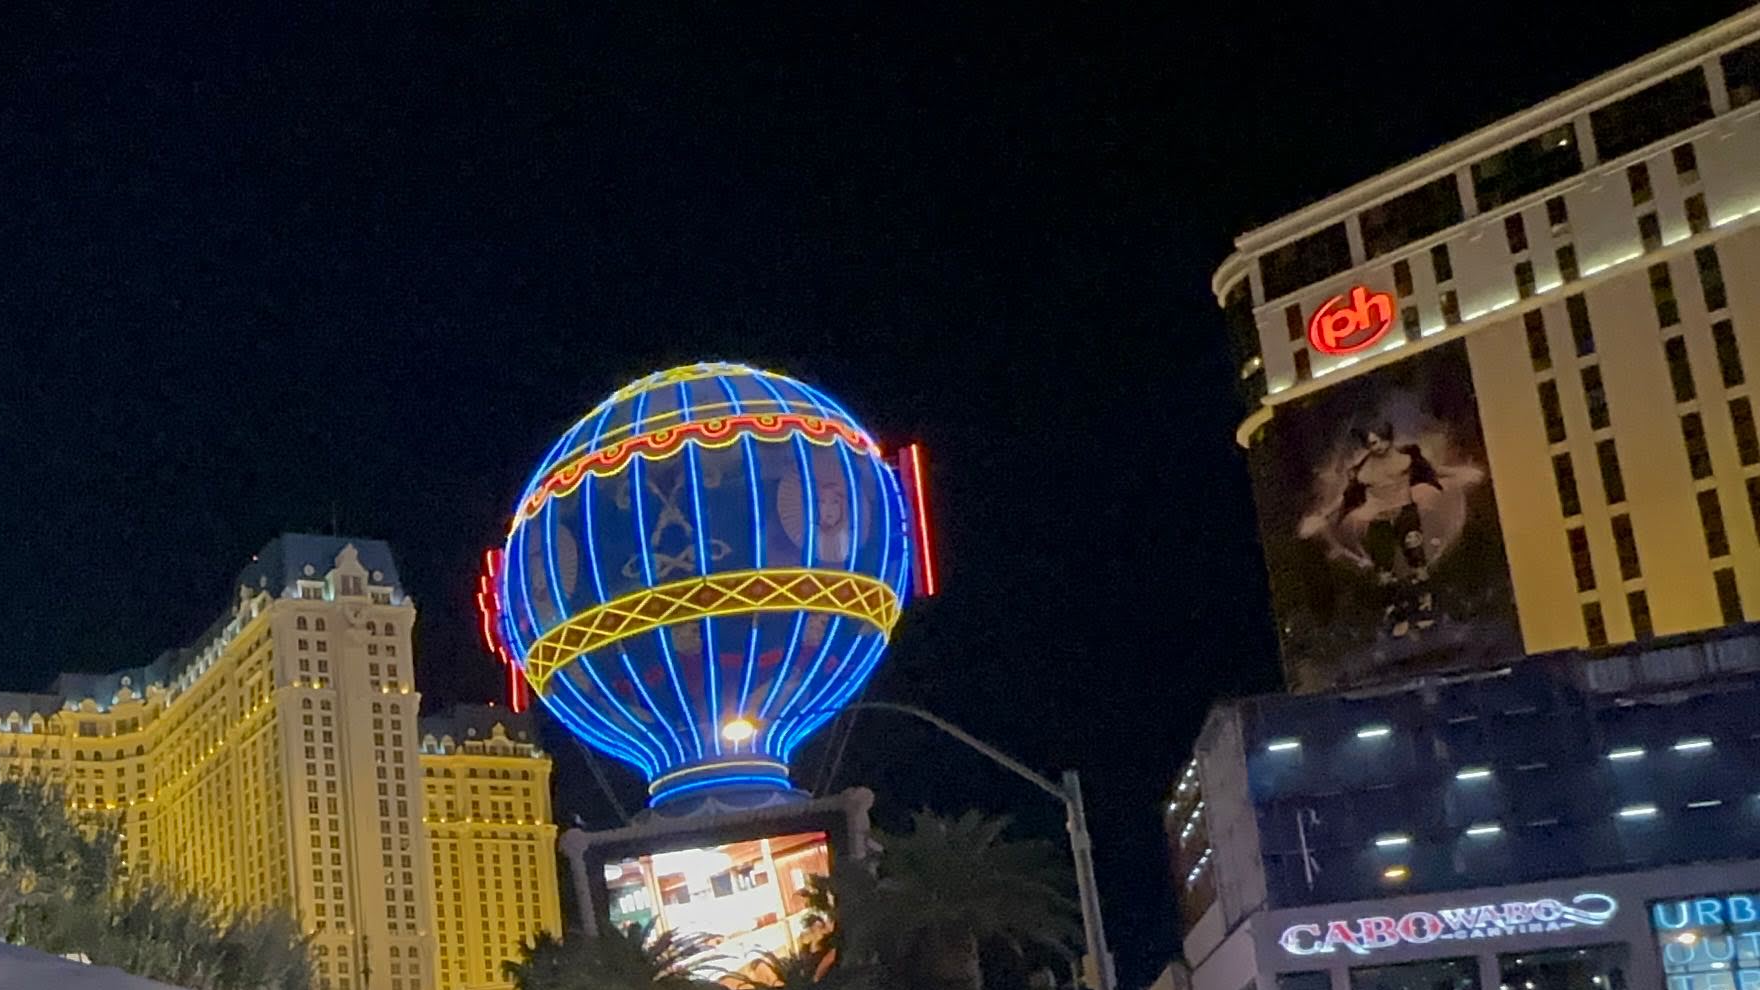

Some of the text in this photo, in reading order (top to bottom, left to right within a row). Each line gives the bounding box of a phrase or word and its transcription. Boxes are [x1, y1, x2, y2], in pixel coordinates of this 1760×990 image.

[1320, 286, 1393, 348] ph
[1278, 898, 1563, 955] CABO WABO
